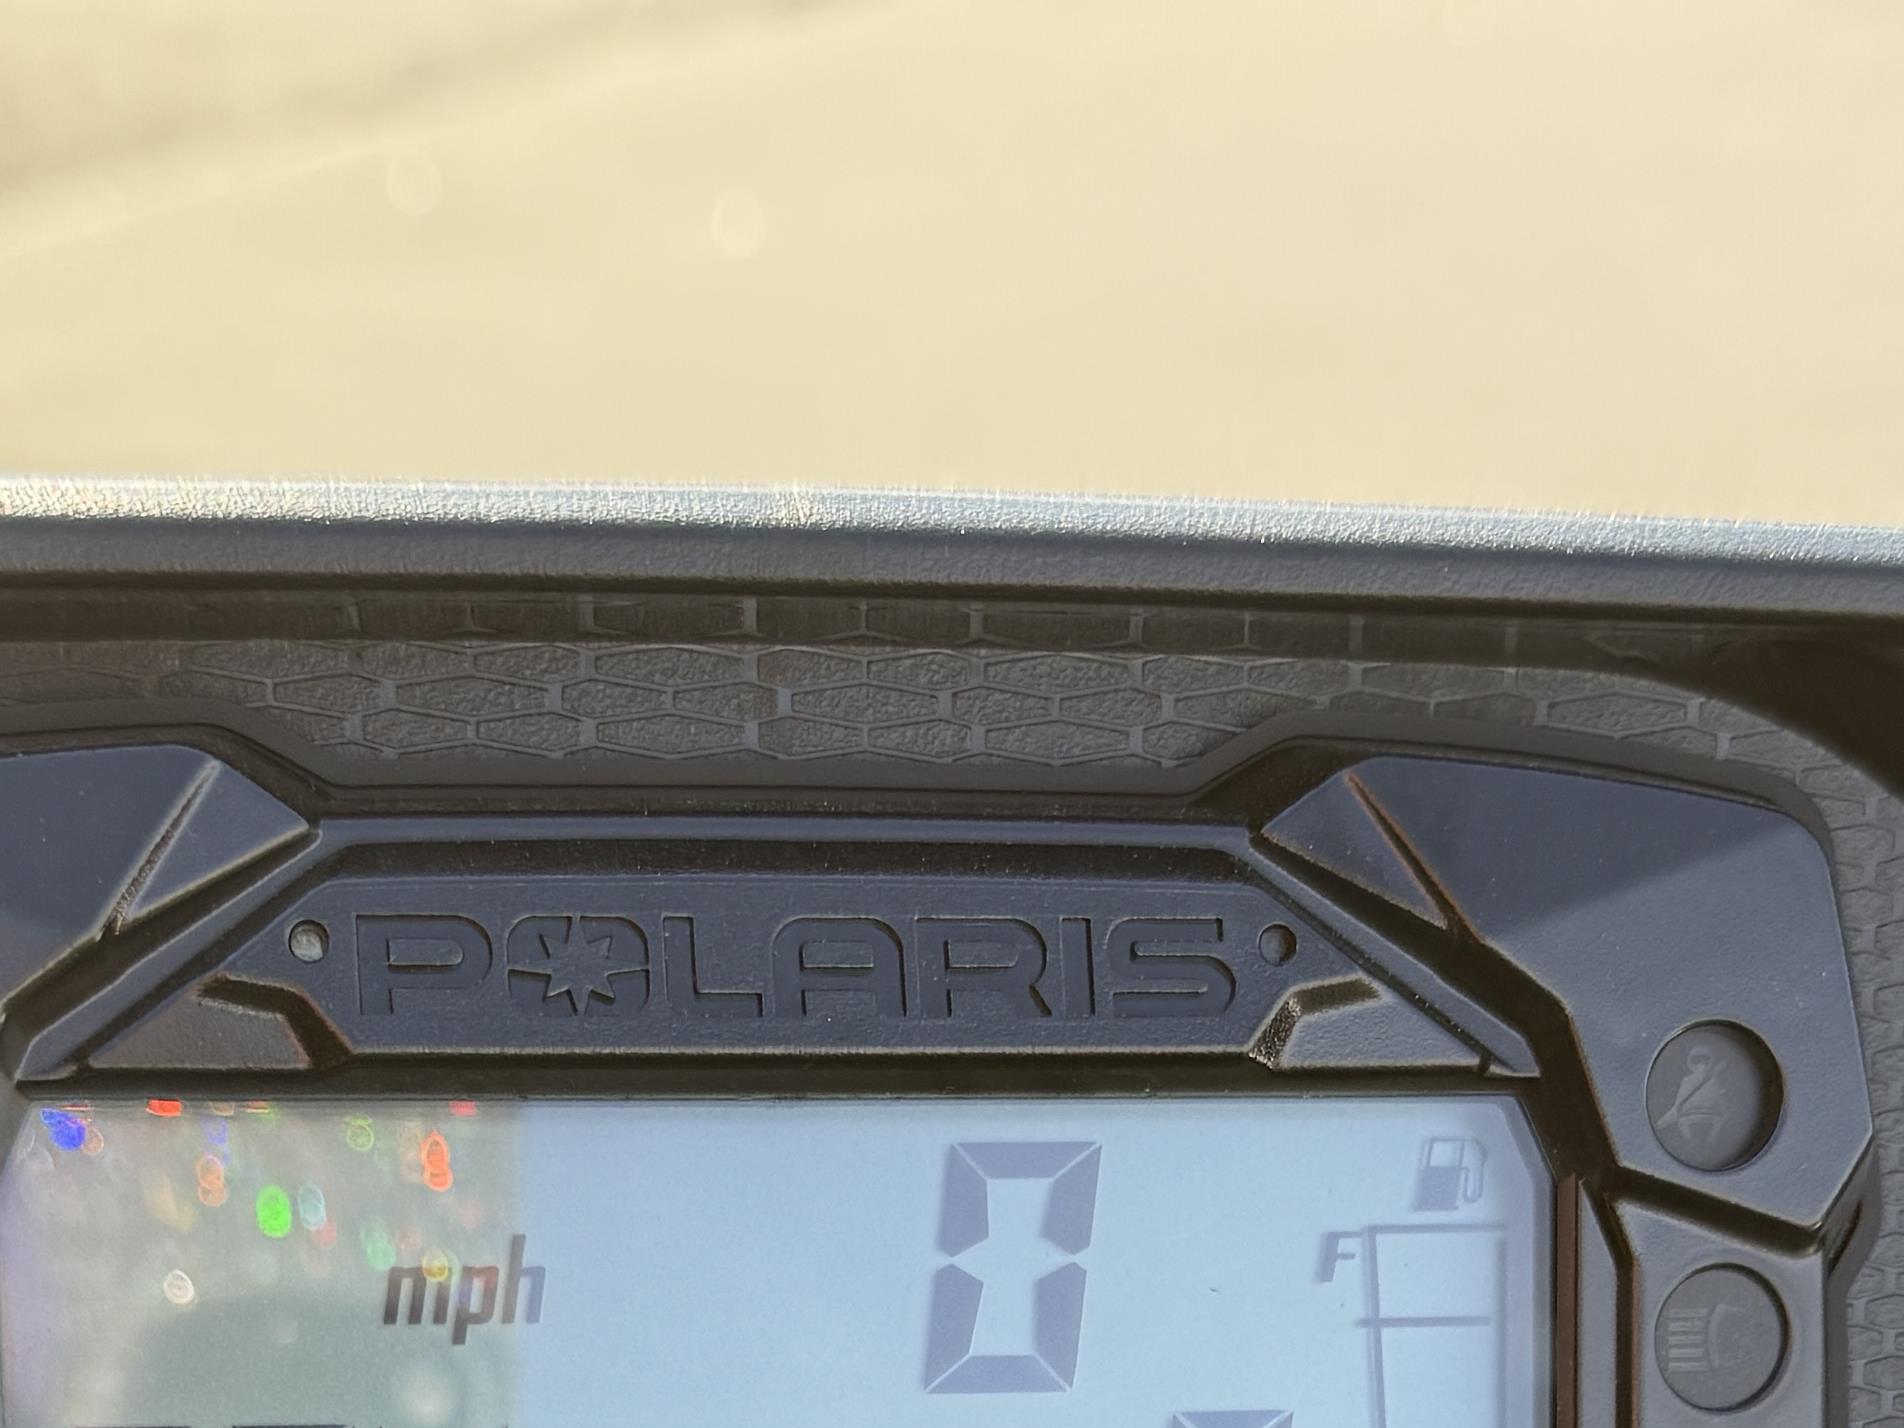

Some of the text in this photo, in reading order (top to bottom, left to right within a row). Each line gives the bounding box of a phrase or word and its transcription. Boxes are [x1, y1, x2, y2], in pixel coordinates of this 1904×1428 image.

[354, 912, 1238, 1018] POLARIS
[382, 1233, 547, 1346] mph
[922, 1140, 1102, 1395] 0
[1318, 1231, 1360, 1284] F
